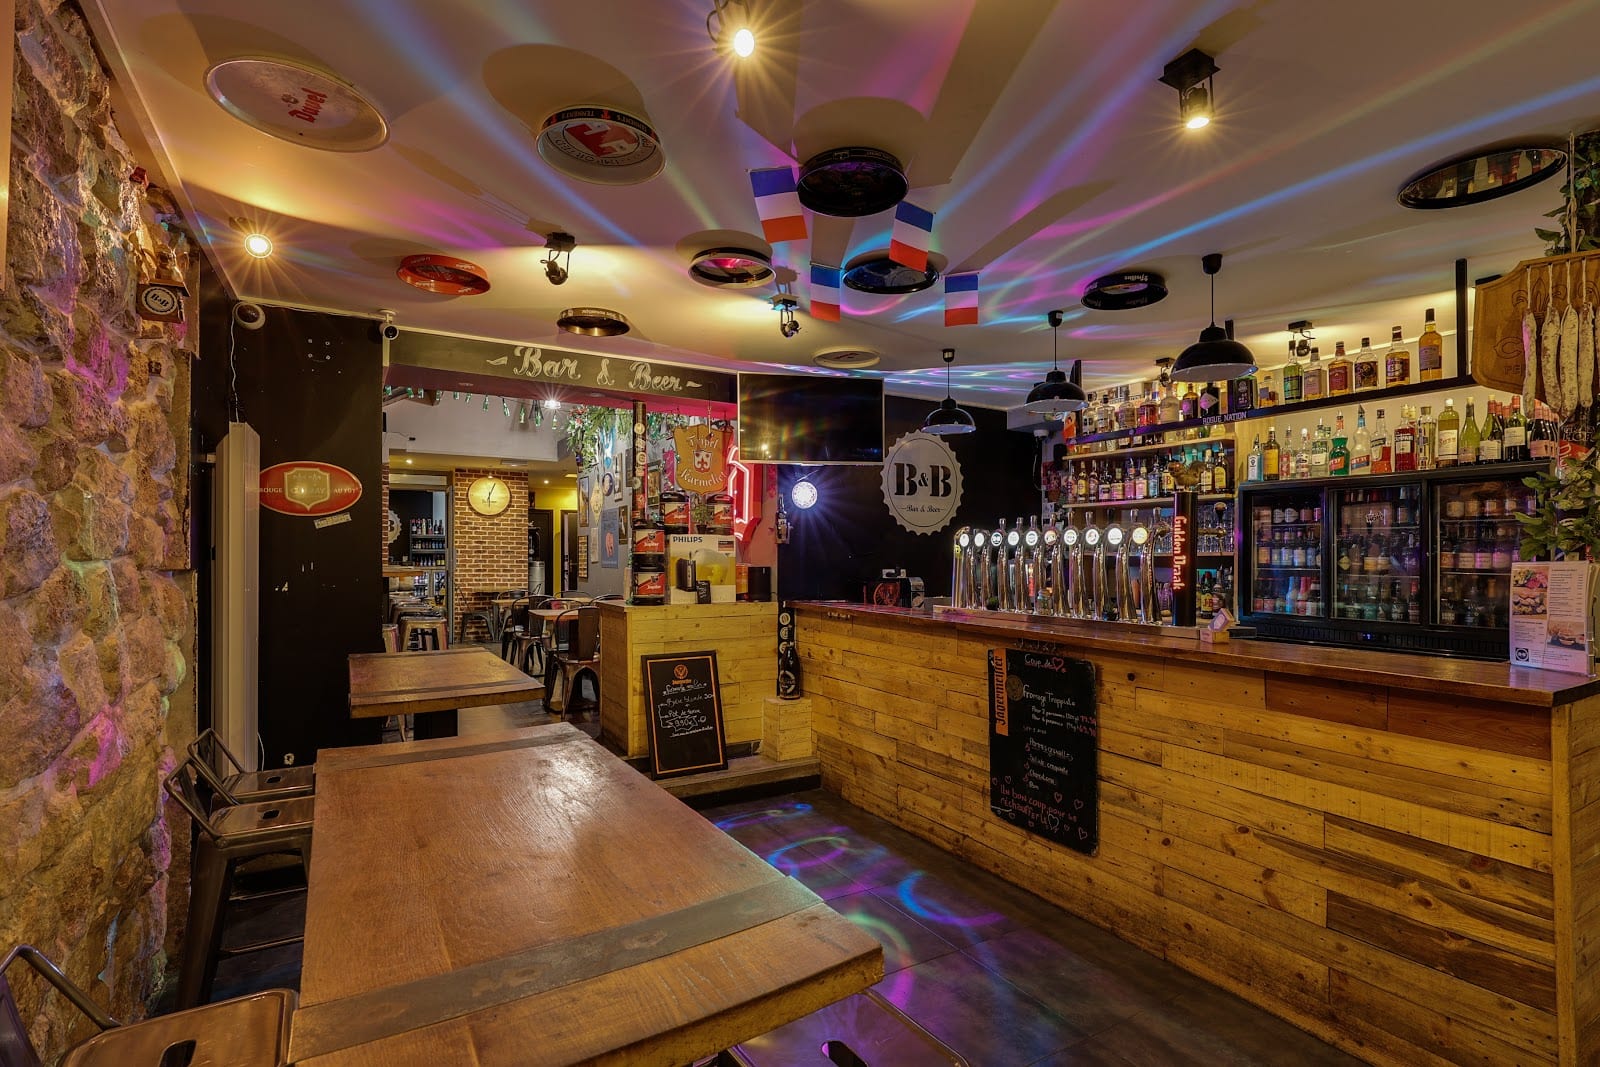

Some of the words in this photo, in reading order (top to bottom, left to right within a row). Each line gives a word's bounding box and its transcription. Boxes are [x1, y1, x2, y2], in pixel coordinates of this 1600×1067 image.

[288, 88, 328, 123] Duvel
[513, 346, 581, 380] Bar
[597, 358, 615, 386] &
[628, 361, 683, 392] Beer
[1202, 416, 1222, 425] ROGUE
[1223, 410, 1248, 422] NATION
[687, 434, 720, 449] Tipel
[894, 462, 952, 498] B&B
[906, 505, 919, 513] Bar
[1173, 515, 1188, 554] Gulden
[1173, 555, 1187, 591] Draak
